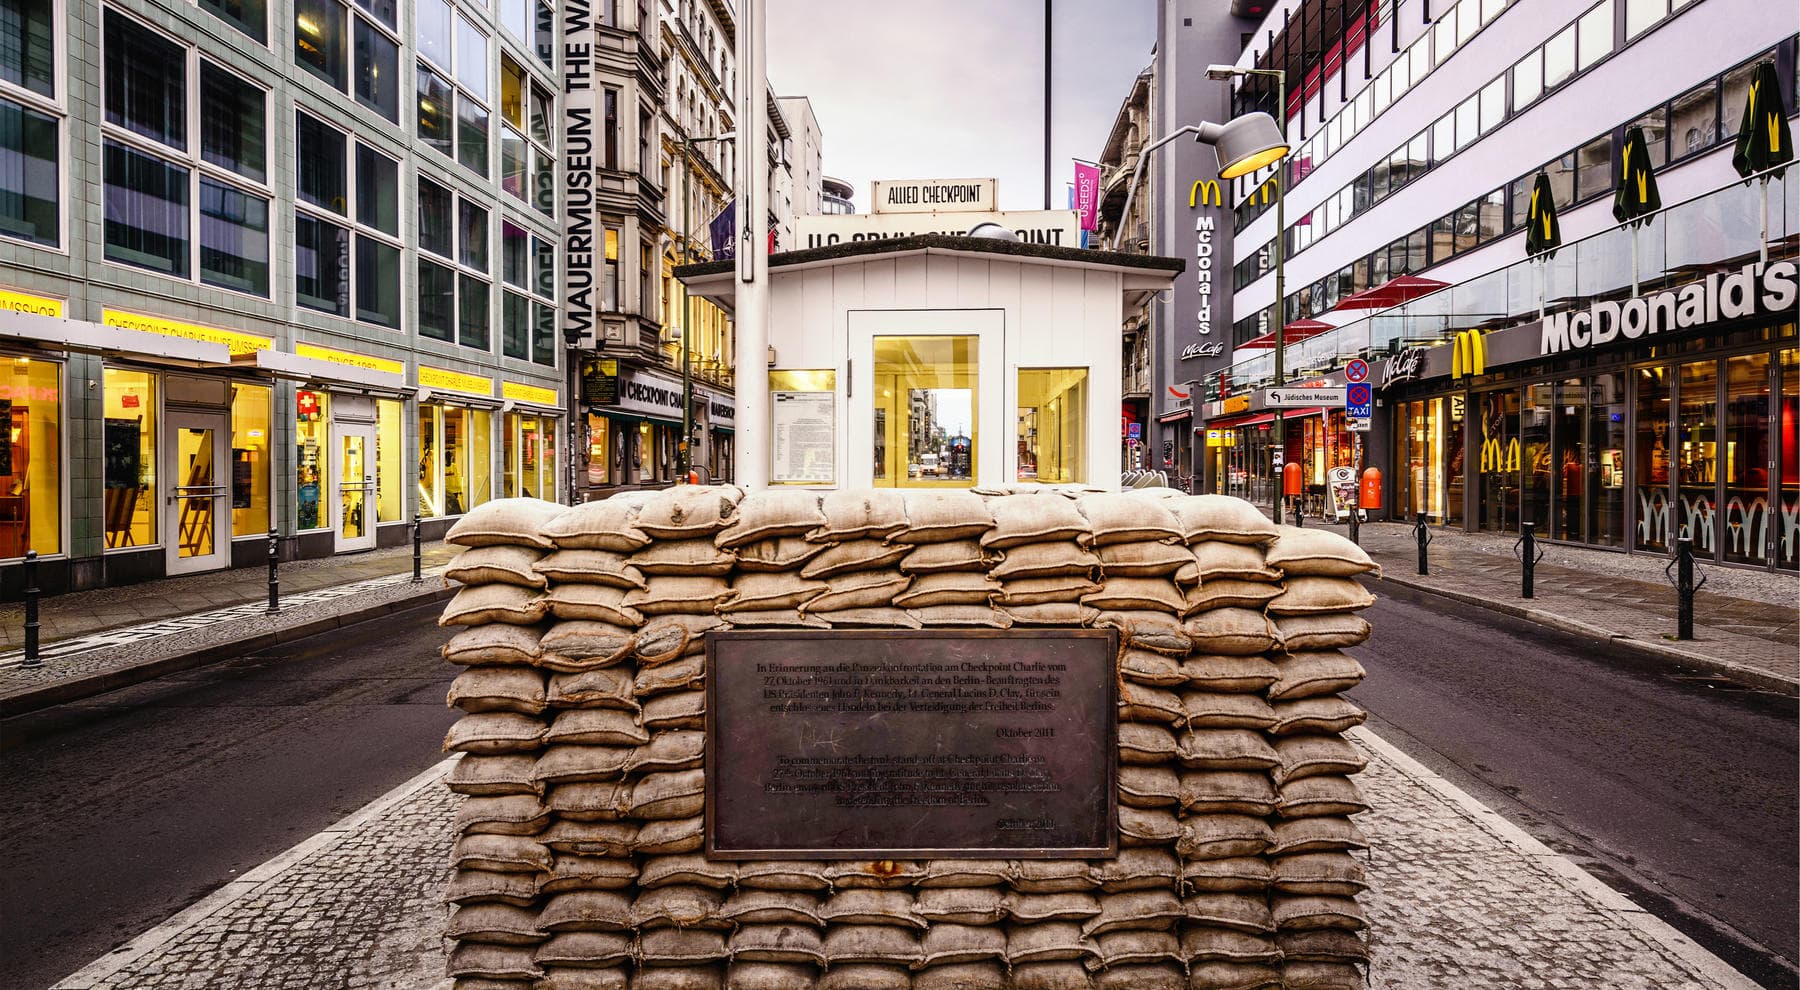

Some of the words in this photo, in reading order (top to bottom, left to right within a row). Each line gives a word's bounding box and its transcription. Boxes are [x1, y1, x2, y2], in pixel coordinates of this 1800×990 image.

[565, 43, 589, 93] THE
[888, 186, 918, 204] ALLIED
[922, 184, 981, 203] CHECKPOINT
[565, 108, 592, 337] MAUERMUSEUM
[1540, 261, 1798, 355] McDonald's
[627, 381, 669, 407] CHECKPOINT
[1284, 393, 1312, 401] Jüdisches
[1314, 393, 1338, 401] Museum
[1348, 407, 1369, 416] TAXI
[757, 663, 767, 672] In
[769, 663, 821, 674] Erinnerung
[837, 663, 850, 672] die
[961, 662, 1011, 674] Checkpoint
[1013, 662, 1046, 672] Charlie
[1048, 664, 1066, 672] vom
[777, 676, 812, 685] Oktober
[834, 676, 852, 685] und
[854, 676, 863, 685] in
[865, 675, 920, 685] Dankbarkeit
[935, 675, 950, 685] den
[1044, 675, 1060, 685] des
[920, 688, 956, 697] General
[958, 688, 986, 698] Lucius
[999, 688, 1022, 699] Clay,
[1040, 689, 1060, 698] sein
[878, 702, 891, 712] bei
[893, 702, 907, 712] der
[909, 701, 967, 714] Verteidigung
[969, 701, 983, 712] der
[985, 701, 1018, 712] Freiheit
[996, 727, 1032, 738] Oktober
[1033, 727, 1056, 738] 2011
